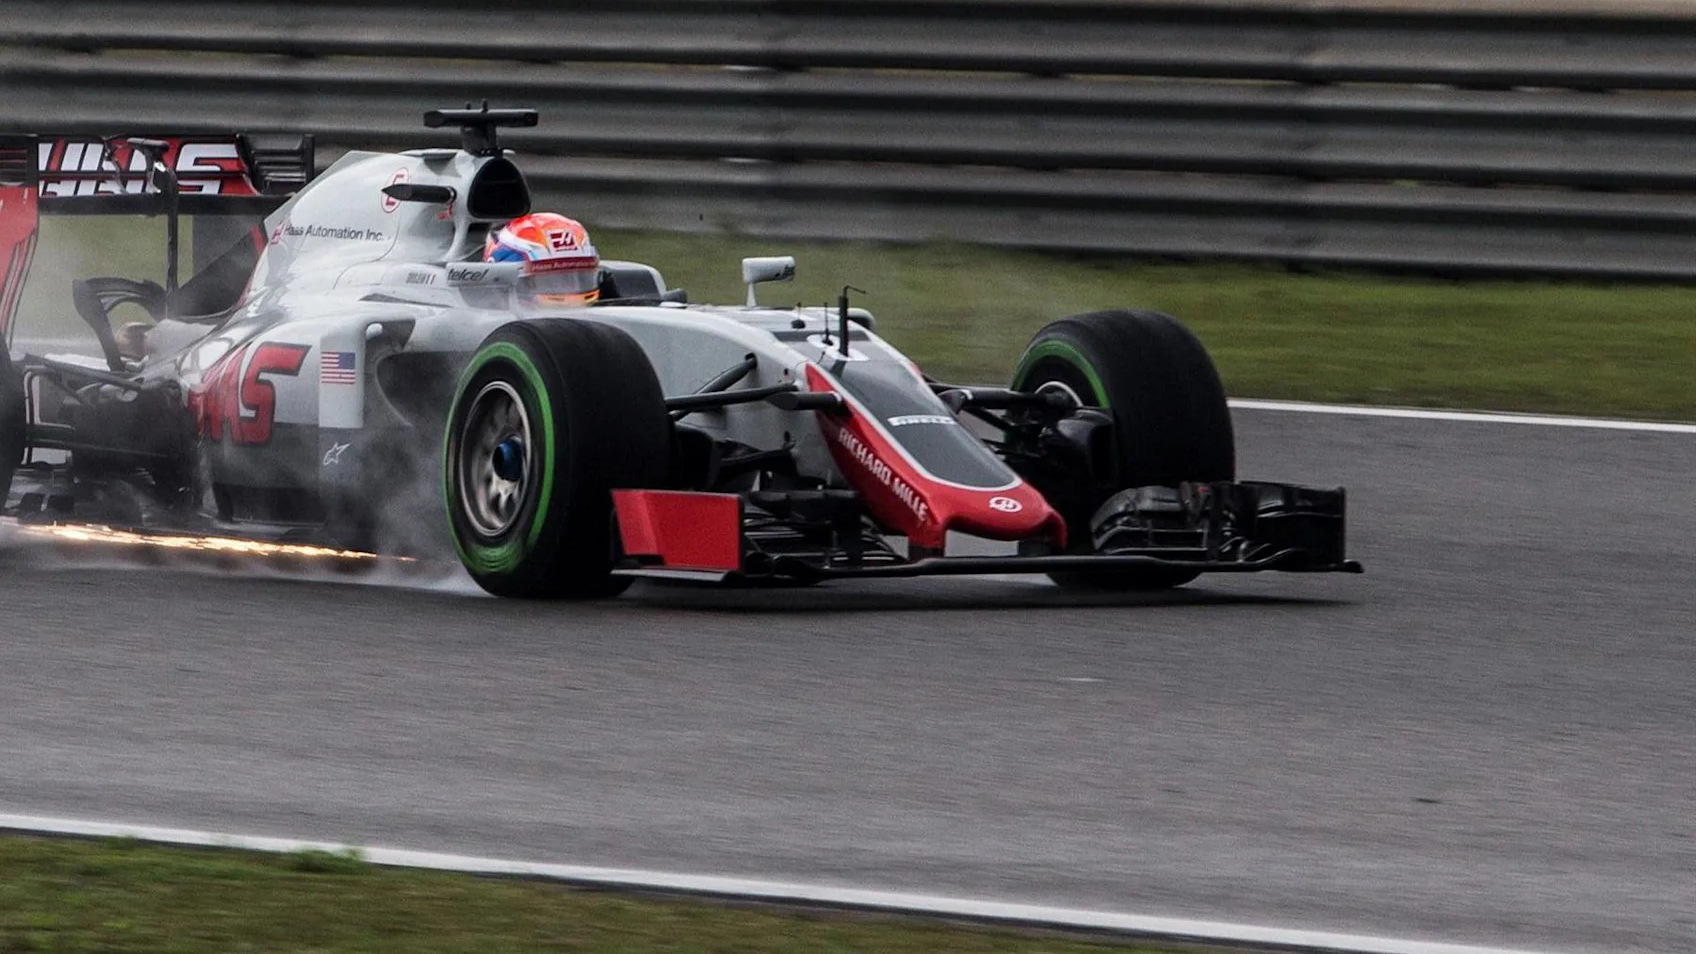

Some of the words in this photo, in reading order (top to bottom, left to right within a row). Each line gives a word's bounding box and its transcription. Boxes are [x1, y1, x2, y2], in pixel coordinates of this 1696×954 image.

[285, 226, 304, 236] Haas
[305, 225, 363, 240] Automation
[366, 229, 384, 241] Inc.
[839, 428, 892, 486] RICHARD
[892, 478, 928, 522] MILLE
